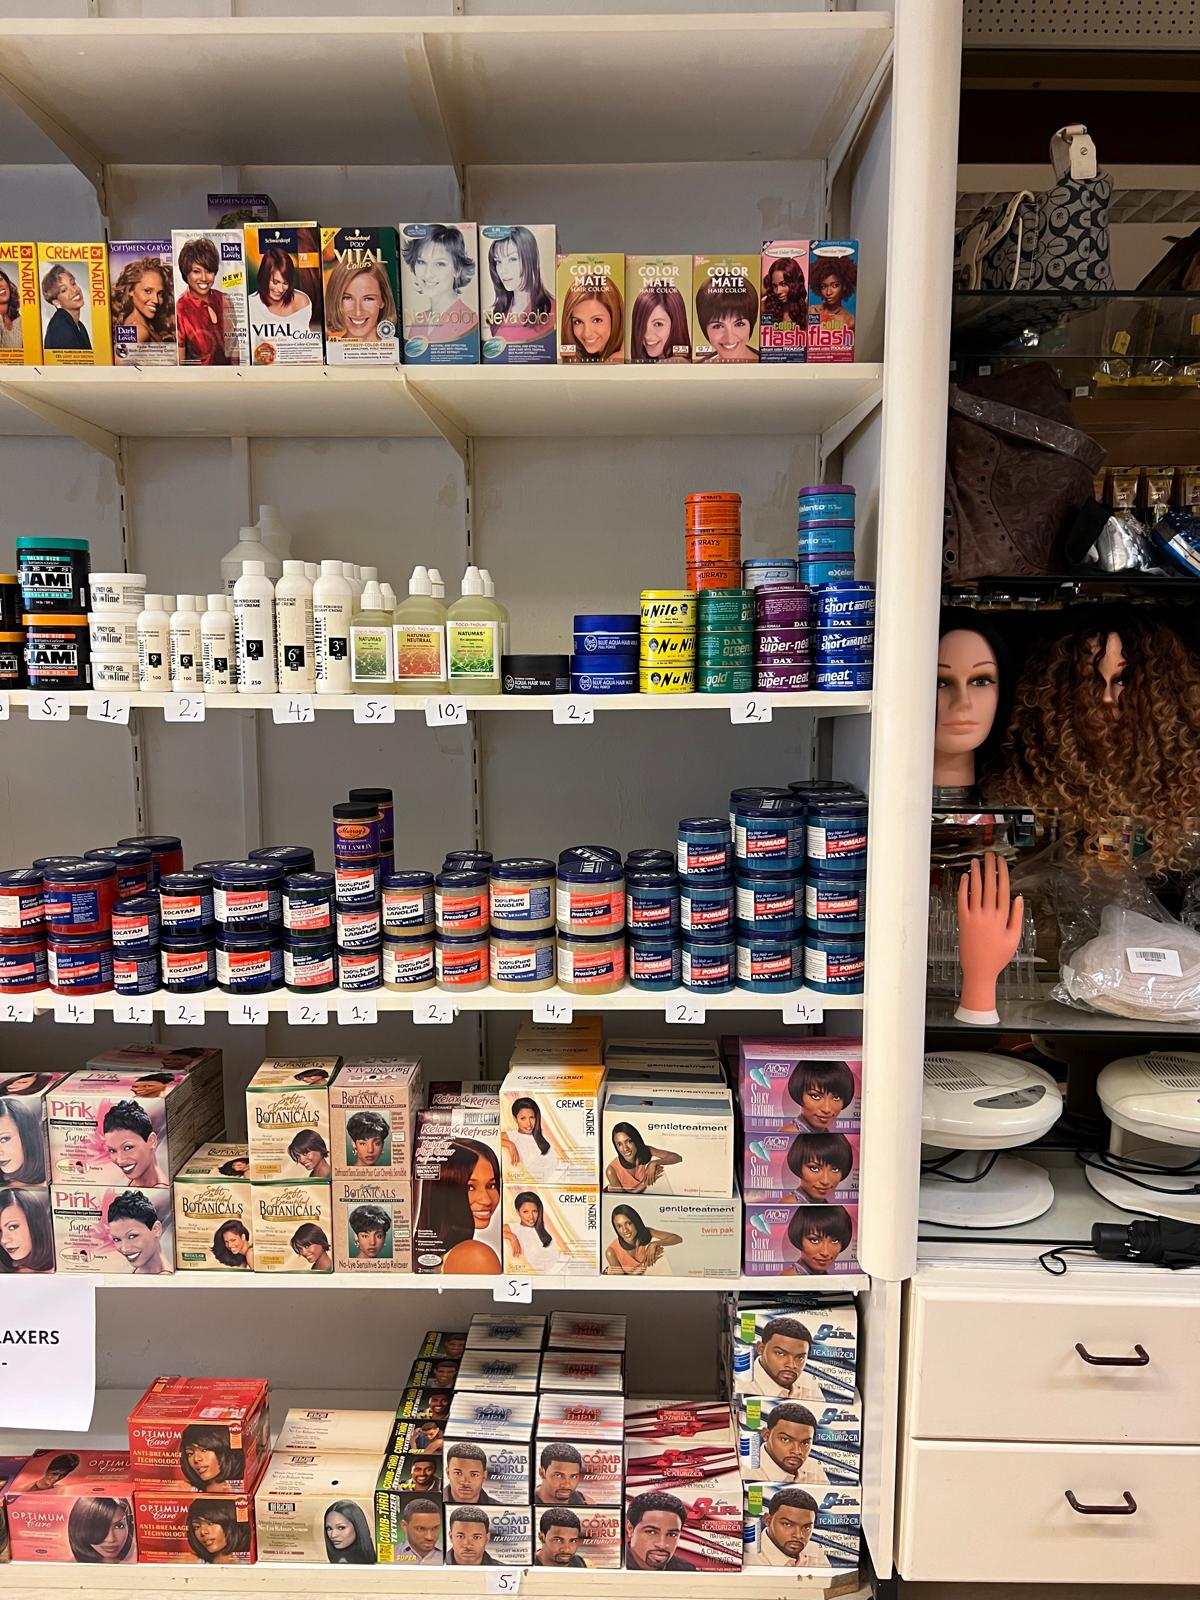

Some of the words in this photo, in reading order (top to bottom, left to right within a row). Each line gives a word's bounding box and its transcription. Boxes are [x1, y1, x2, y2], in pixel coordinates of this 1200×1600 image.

[46, 246, 88, 259] CREME
[91, 249, 102, 257] OF
[334, 249, 388, 264] VITAL
[347, 262, 372, 270] Colors
[570, 265, 611, 276] COLOR
[639, 266, 679, 276] COLOR
[707, 266, 748, 276] COLOR
[222, 273, 243, 281] NEW!
[575, 276, 607, 286] MATE
[643, 277, 675, 287] MATE
[712, 277, 744, 287] MATE
[22, 262, 35, 304] NATURE
[93, 262, 105, 305] NATURE
[484, 309, 552, 325] Nevacolor
[252, 324, 293, 336] VITAL
[773, 322, 796, 330] color
[293, 331, 321, 340] Colors
[761, 325, 806, 346] flash
[808, 325, 853, 346] flash
[22, 573, 70, 587] JAM!
[651, 604, 678, 618] Nile
[825, 601, 854, 613] short
[658, 639, 678, 654] Nu
[821, 638, 846, 650] short
[723, 644, 752, 656] green
[29, 651, 75, 664] JAM!
[661, 672, 680, 687] Nu
[707, 673, 728, 686] gold
[825, 670, 849, 682] neat
[757, 838, 787, 847] POMADE
[699, 854, 726, 863] POMADE
[339, 884, 370, 892] LANOLIN
[228, 903, 263, 912] KOCATAH
[767, 899, 793, 909] POMADE
[828, 900, 857, 908] POMADE
[702, 909, 729, 919] POMADE
[345, 927, 376, 936] LANOLIN
[169, 964, 203, 973] KOCATAH
[231, 964, 265, 972] KOCATAH
[398, 962, 430, 973] LANOLIN
[763, 958, 791, 969] POMADE
[702, 966, 729, 975] POMADE
[342, 1091, 394, 1104] BOTANICALS
[434, 1095, 461, 1104] Relax
[751, 1084, 769, 1104] SILKY
[51, 1102, 92, 1118] Pink
[256, 1108, 320, 1123] BOTANICALS
[751, 1104, 774, 1116] TEXTURE
[464, 1113, 500, 1124] PROFECTIV
[556, 1100, 584, 1108] CREME
[586, 1109, 595, 1136] NATURE
[421, 1125, 450, 1134] Relax
[461, 1127, 498, 1136] Refresh
[648, 1123, 728, 1132] gentletreatment
[65, 1132, 87, 1143] Super
[751, 1156, 768, 1176] SILKY
[751, 1176, 773, 1188] TEXTURE
[344, 1185, 395, 1198] BOTANICALS
[55, 1192, 97, 1207] Pink
[183, 1198, 243, 1214] BOTANICALS
[260, 1201, 321, 1216] BOTANICALS
[559, 1195, 587, 1203] CREME
[588, 1204, 597, 1230] NATURE
[69, 1221, 92, 1232] Super
[752, 1230, 769, 1249] SILKY
[378, 1262, 390, 1270] Scalp
[0, 1330, 59, 1344] AXERS
[814, 1349, 854, 1359] TEXTURIZER
[133, 1430, 181, 1440] OPTIMUM
[146, 1437, 170, 1447] Care
[489, 1454, 528, 1464] COMB
[581, 1454, 621, 1464] COMB
[383, 1455, 399, 1490] COMB-THRU
[492, 1464, 525, 1473] THRU
[585, 1463, 617, 1473] THRU
[140, 1505, 188, 1514] OPTIMUM
[12, 1512, 64, 1521] OPTIMUM
[153, 1511, 177, 1520] Care
[380, 1492, 389, 1543] COMB-THRU
[390, 1494, 399, 1543] TEXTURIZER
[492, 1516, 530, 1525] COMB
[582, 1519, 620, 1528] COMB
[495, 1525, 527, 1534] THRU
[585, 1528, 617, 1537] THRU
